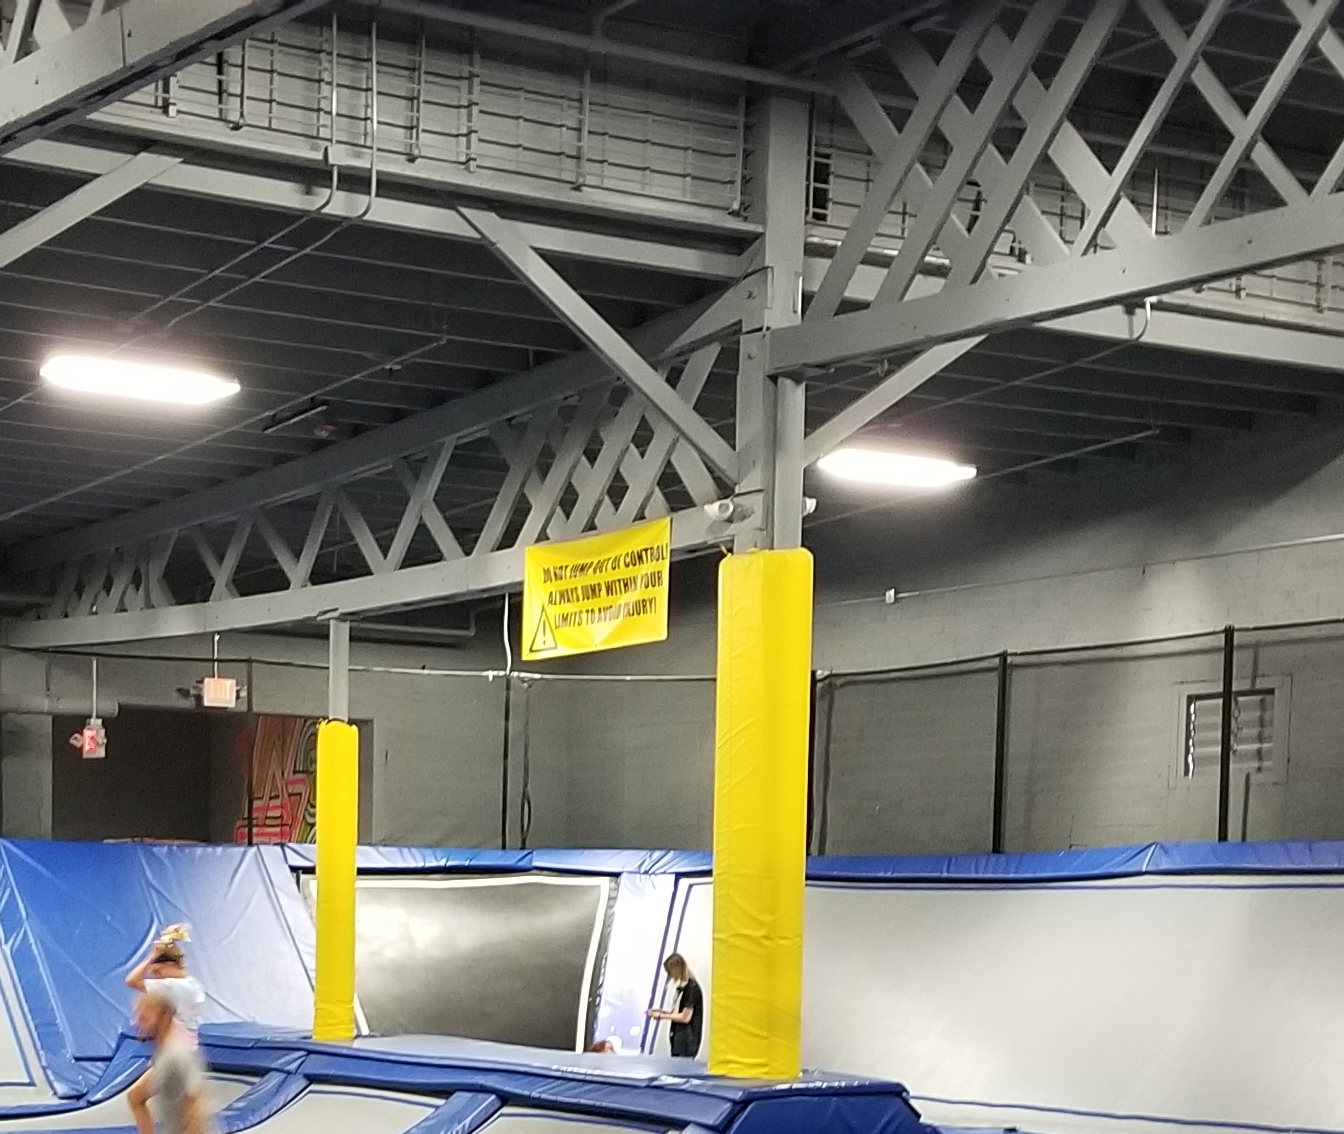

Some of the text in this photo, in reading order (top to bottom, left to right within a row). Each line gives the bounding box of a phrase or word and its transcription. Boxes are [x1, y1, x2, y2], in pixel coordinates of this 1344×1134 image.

[554, 564, 570, 582] NOT
[570, 561, 594, 579] JUMP
[593, 556, 613, 575] OUT
[547, 585, 580, 607] ALWAYS
[581, 581, 602, 601] JUMP
[603, 574, 639, 597] WITHIN
[554, 609, 584, 630] LIMITS
[585, 608, 596, 626] TO
